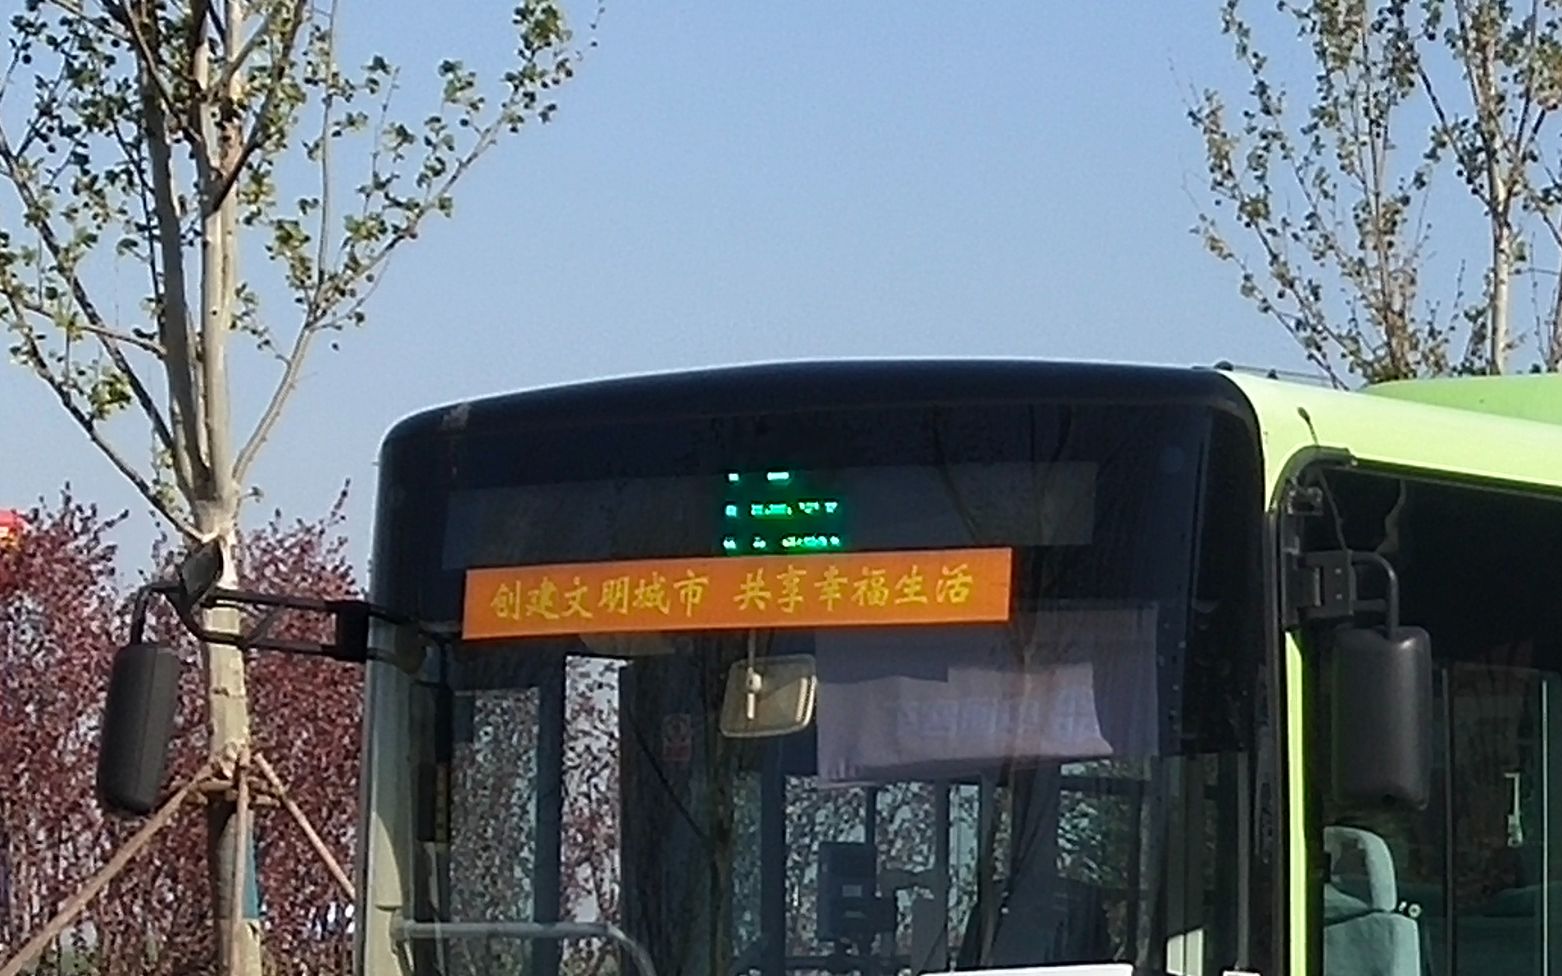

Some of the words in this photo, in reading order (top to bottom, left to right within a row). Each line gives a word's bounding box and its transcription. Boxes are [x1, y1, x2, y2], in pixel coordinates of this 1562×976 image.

[490, 571, 710, 622] 创建文明城市
[733, 565, 974, 615] 共享幸福生活
